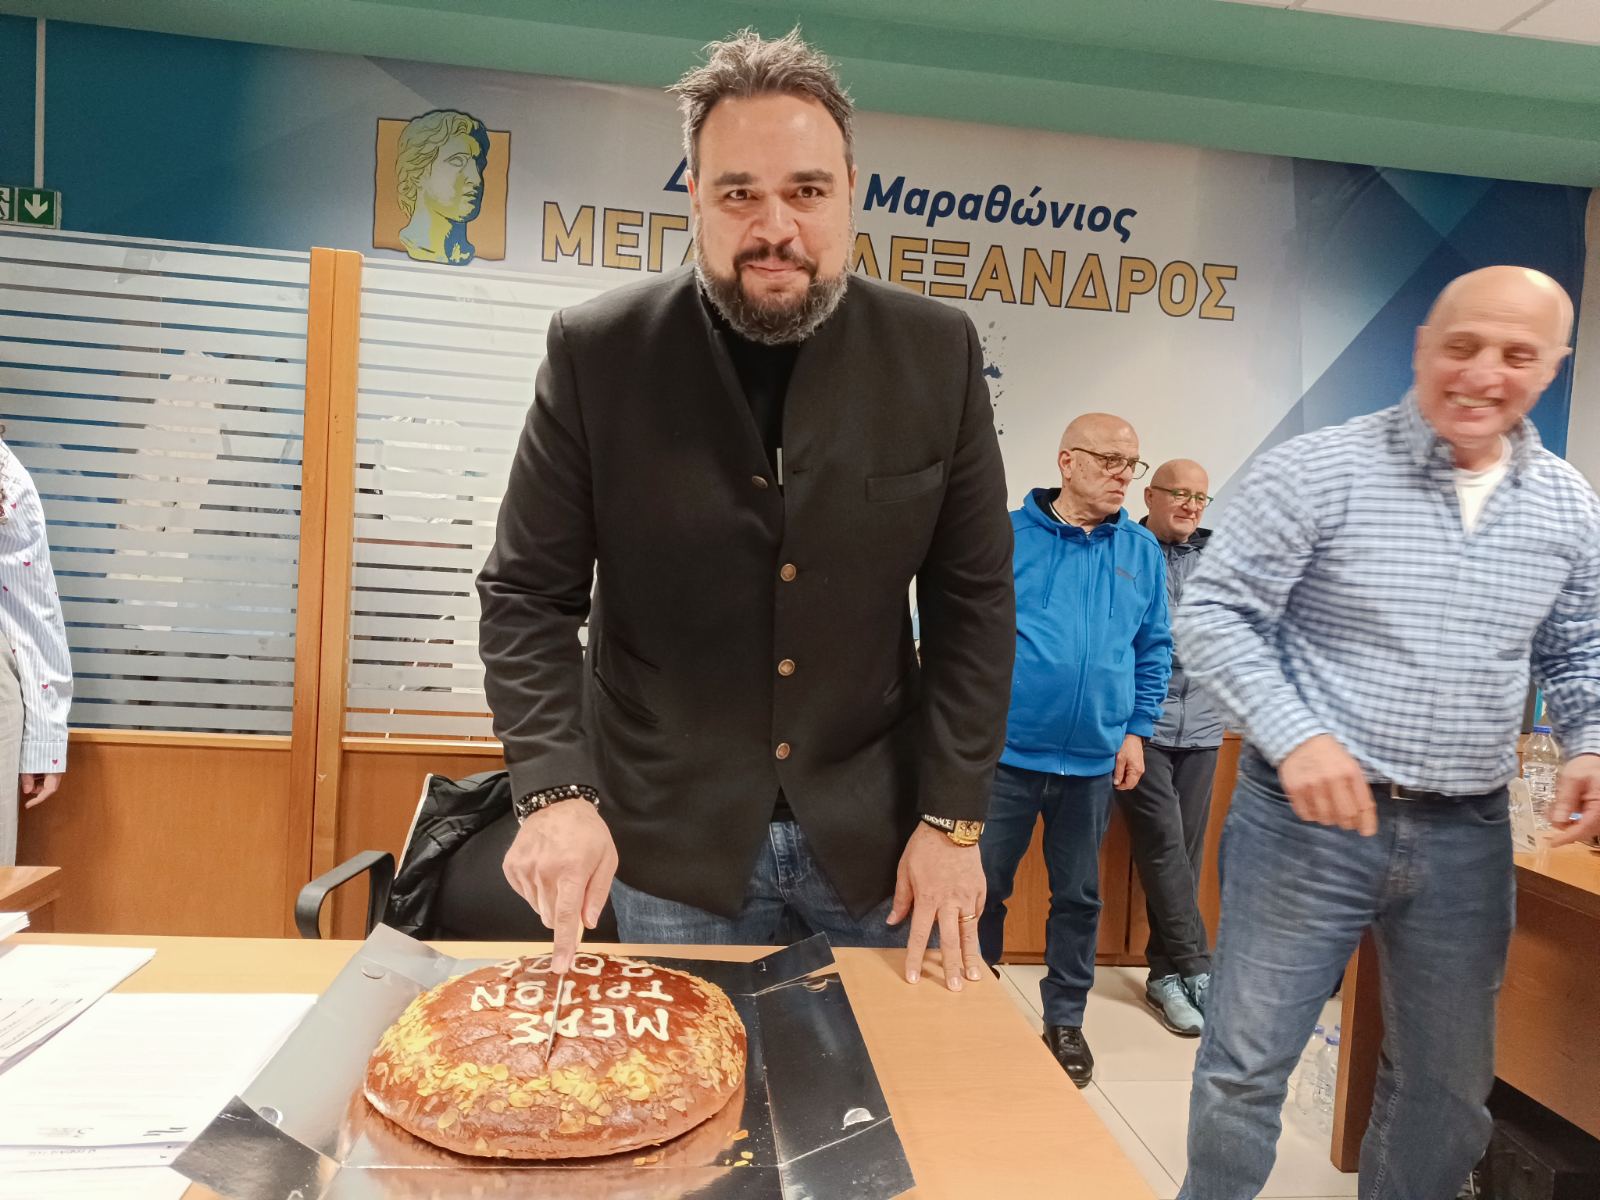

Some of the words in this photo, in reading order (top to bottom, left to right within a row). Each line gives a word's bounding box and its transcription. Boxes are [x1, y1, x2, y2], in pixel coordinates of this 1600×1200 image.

[863, 173, 1138, 244] Μαραθώνιος
[541, 201, 694, 273] ΜΕΓ
[852, 231, 1239, 322] ΛΕΞΑΝΔΡΟΣ
